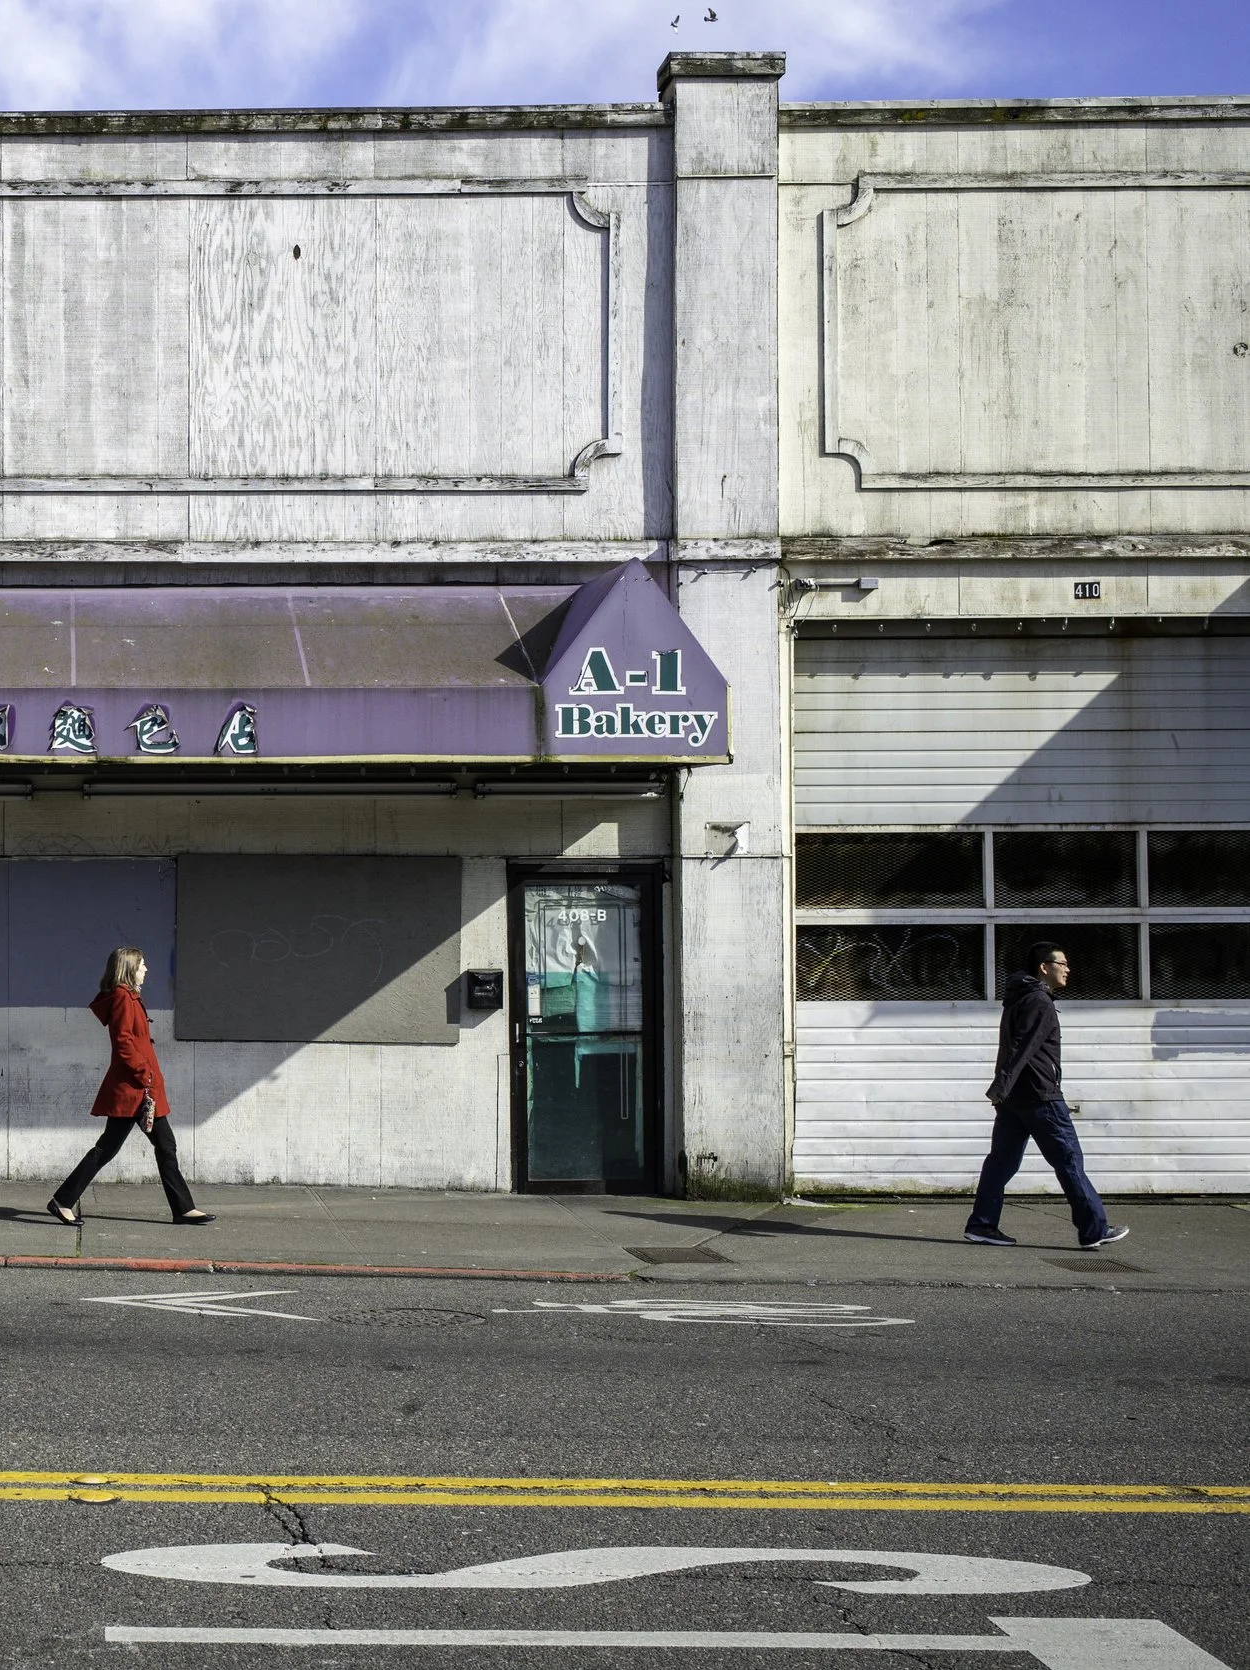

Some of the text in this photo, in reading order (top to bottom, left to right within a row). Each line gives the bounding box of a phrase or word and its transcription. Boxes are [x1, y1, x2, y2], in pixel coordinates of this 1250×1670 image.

[1075, 583, 1100, 598] 410
[569, 647, 686, 695] A-1
[555, 703, 718, 747] Bakery
[558, 909, 607, 922] 408-B
